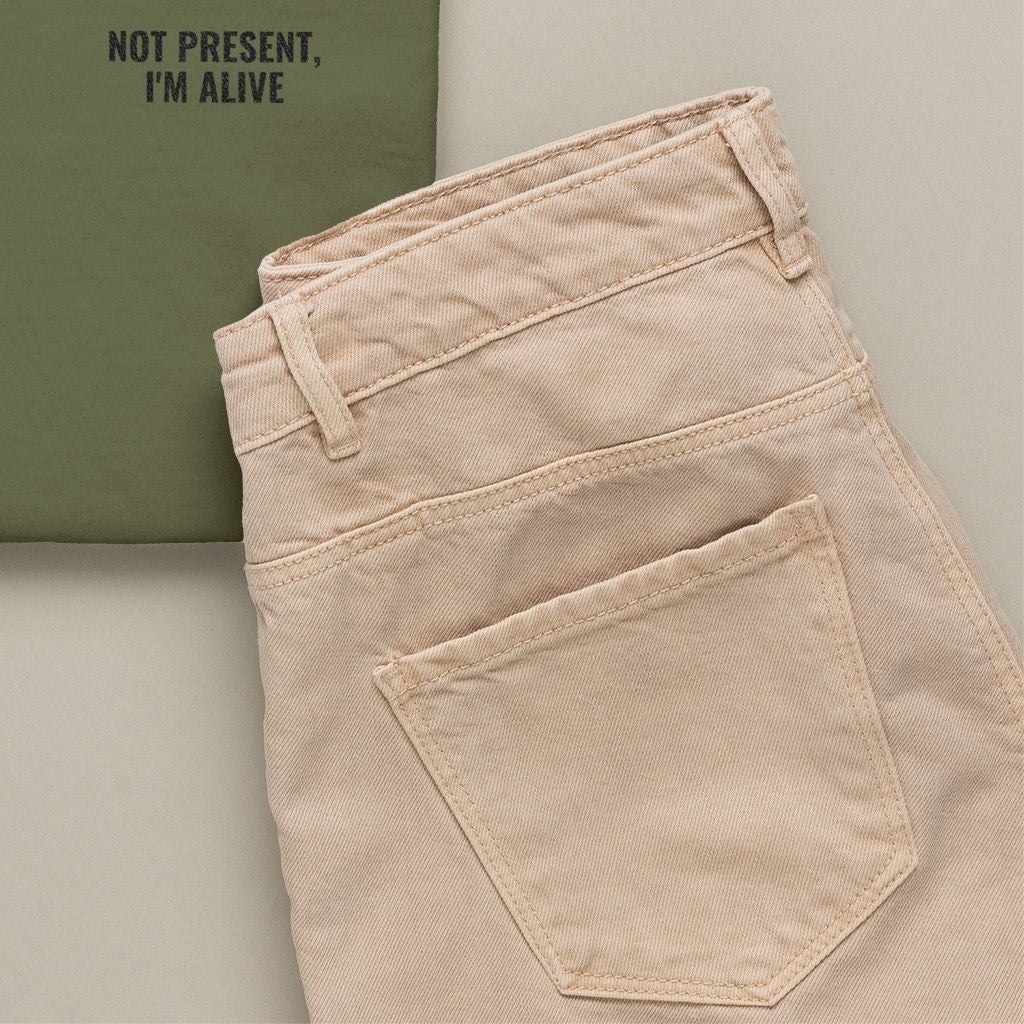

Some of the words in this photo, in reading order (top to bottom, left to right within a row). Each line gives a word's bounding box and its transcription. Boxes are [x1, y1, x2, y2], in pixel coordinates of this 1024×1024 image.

[108, 30, 167, 63] NOT
[178, 30, 320, 69] PRESENT,
[146, 71, 187, 103] I'M
[199, 71, 284, 103] ALIVE
